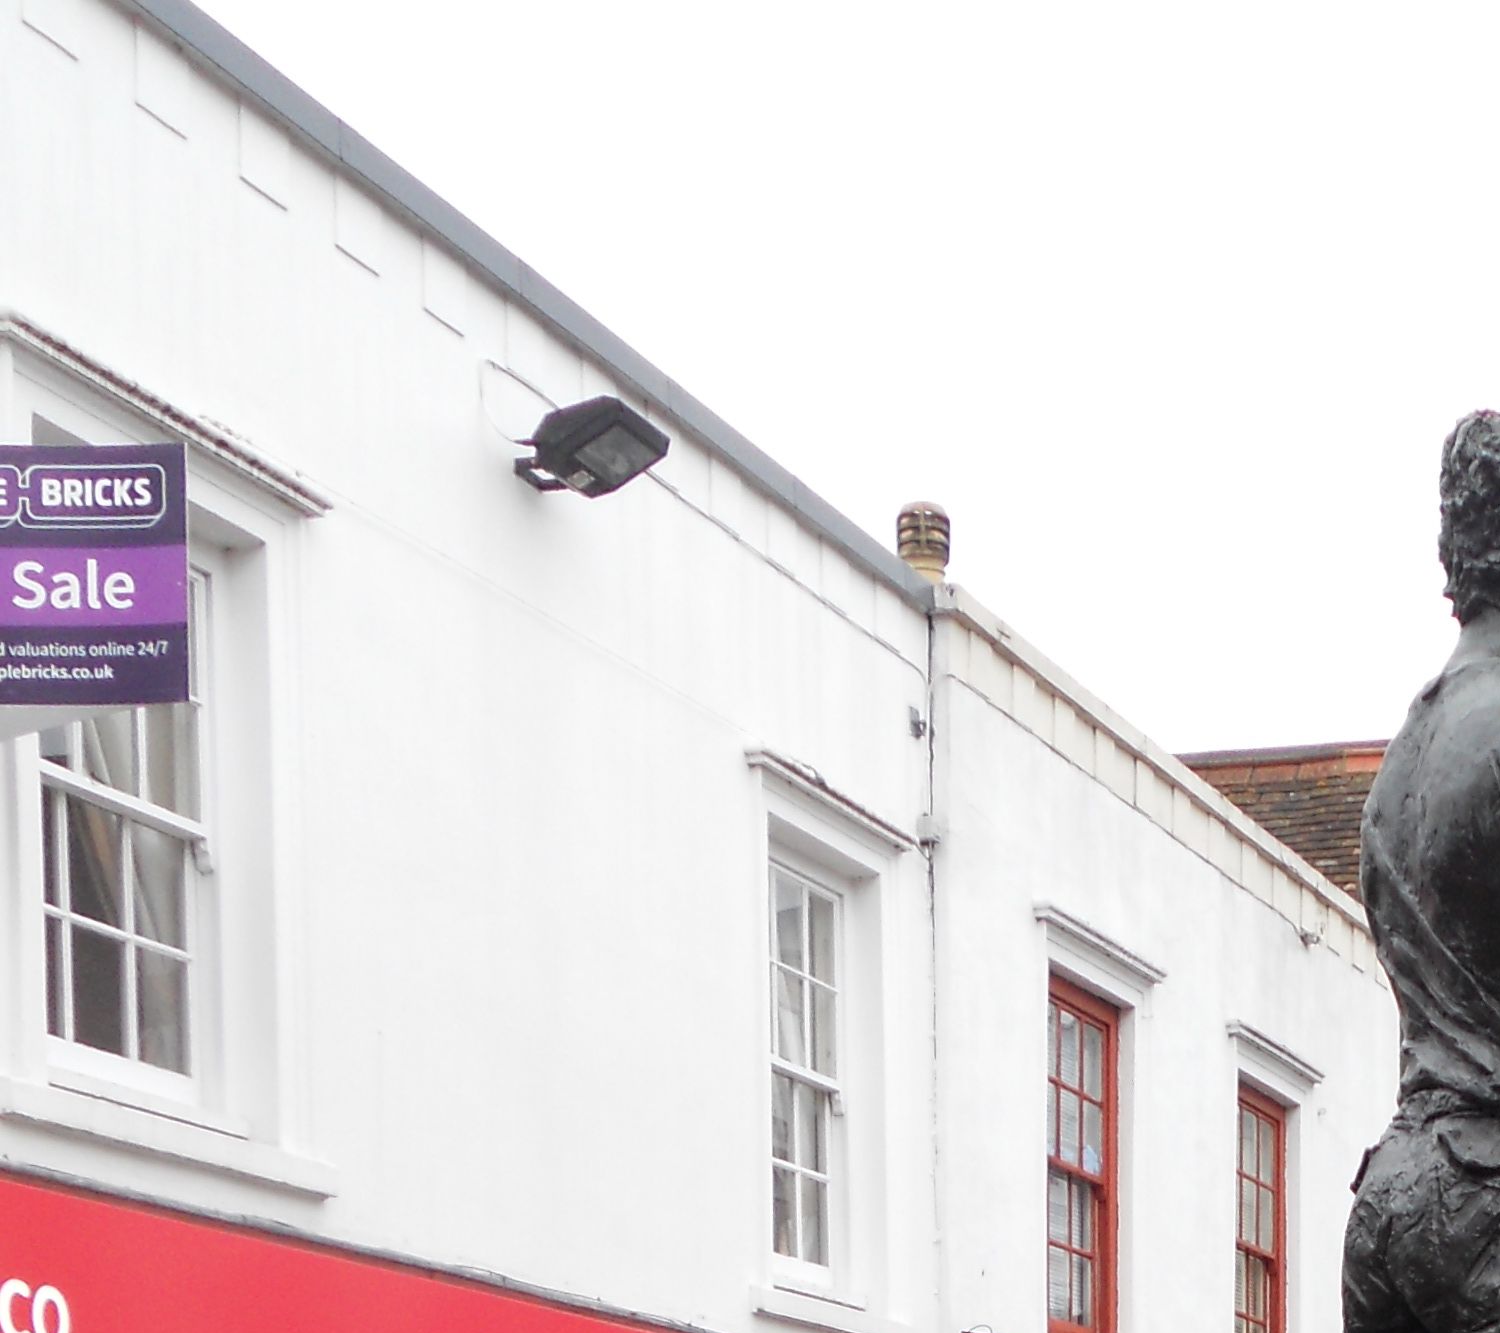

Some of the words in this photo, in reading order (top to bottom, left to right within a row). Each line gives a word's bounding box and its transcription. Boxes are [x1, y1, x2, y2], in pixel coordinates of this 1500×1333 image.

[41, 478, 152, 507] BRICKS
[12, 559, 135, 609] Sale
[8, 642, 87, 657] valuations
[88, 643, 135, 656] online
[137, 640, 169, 657] 24/7
